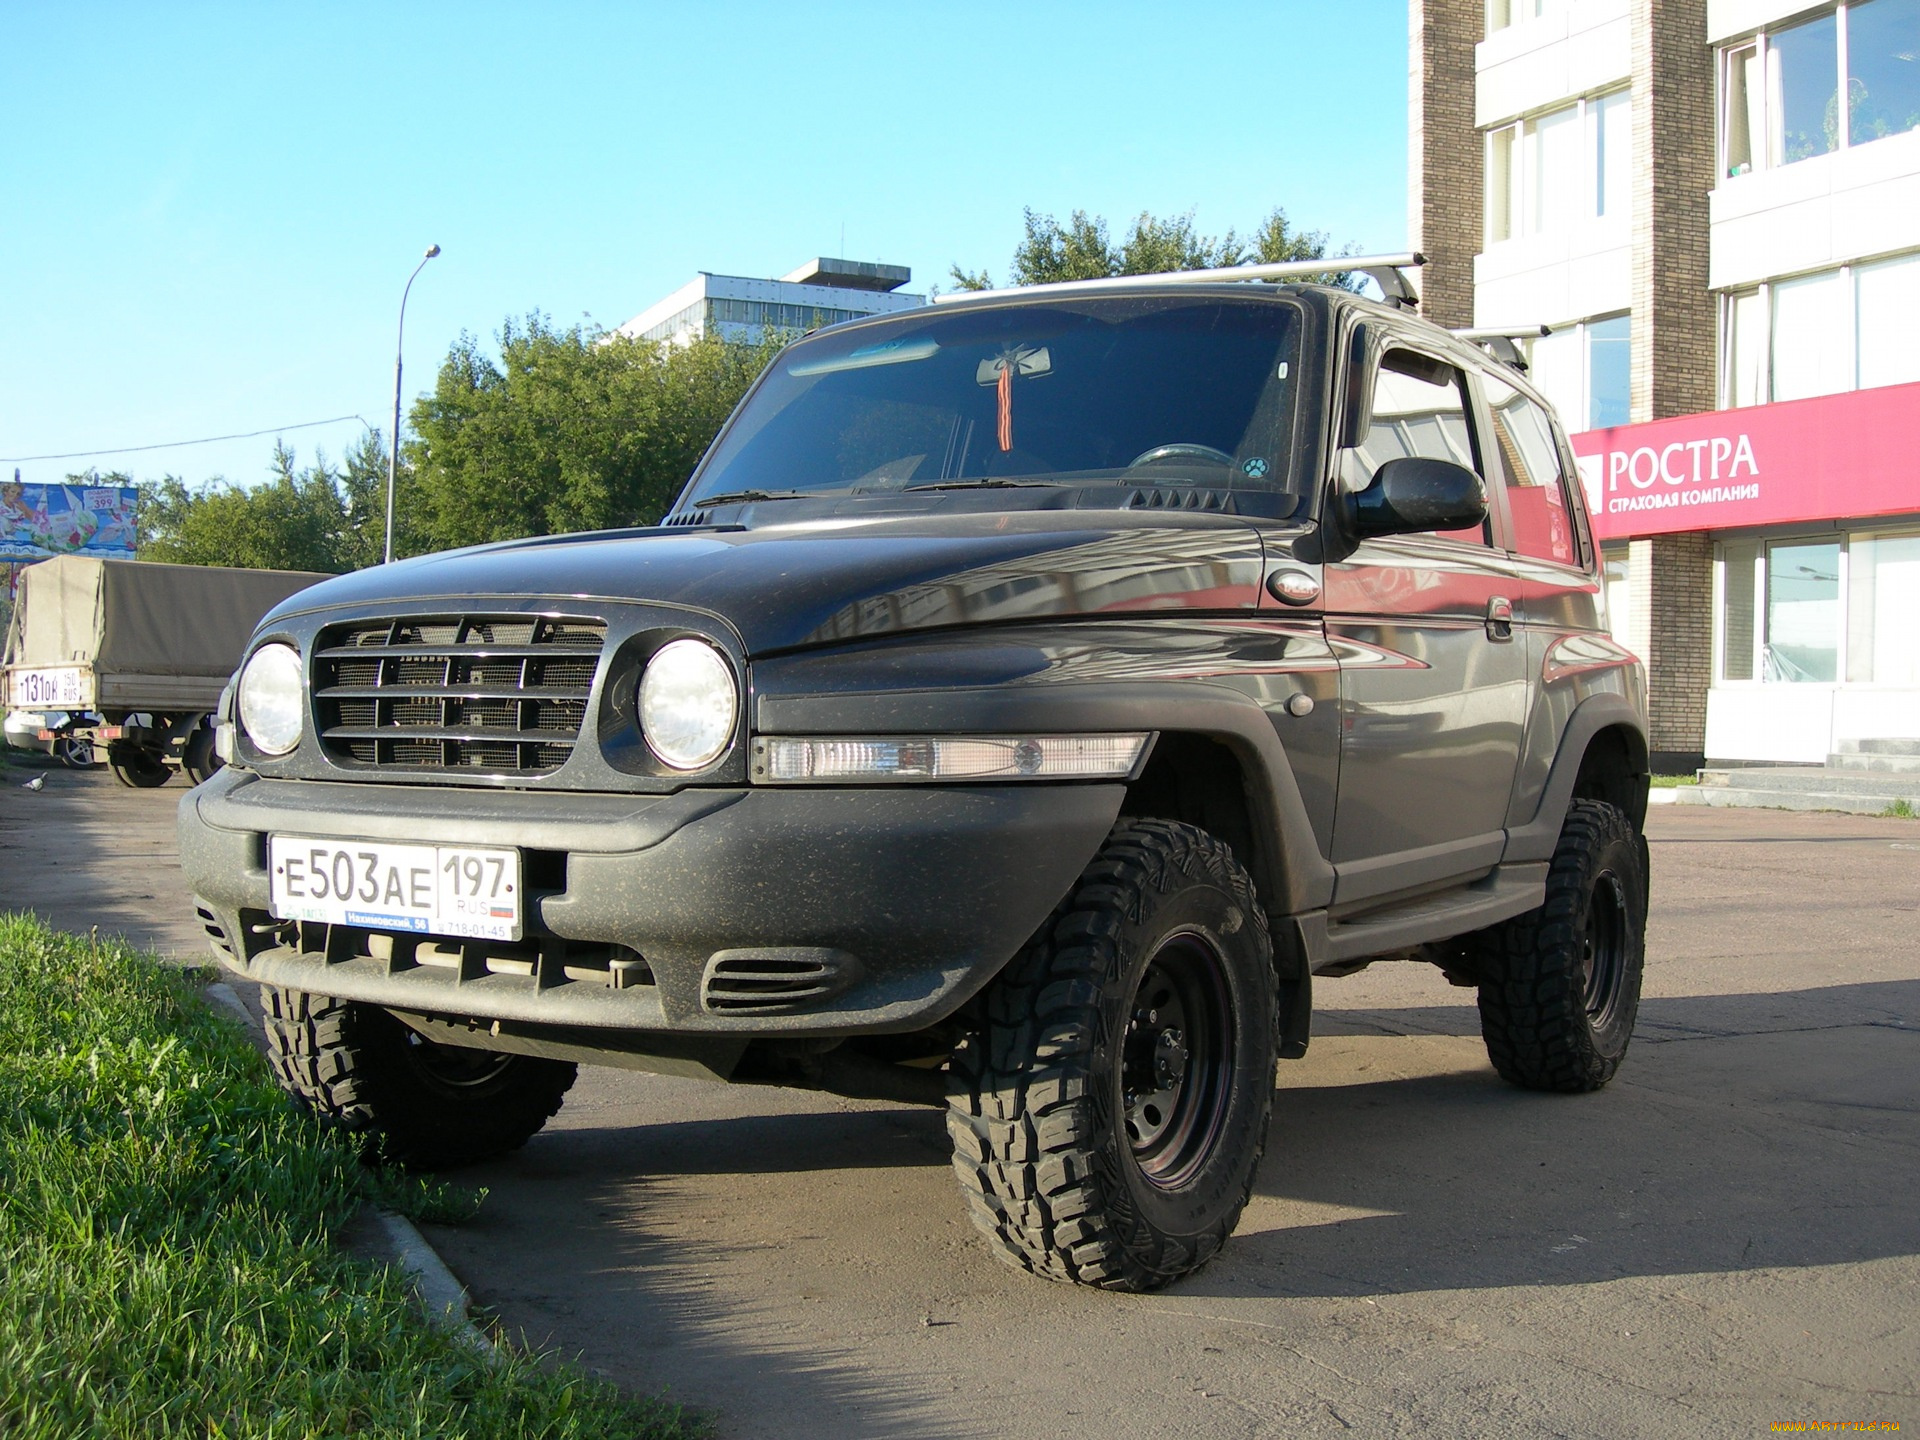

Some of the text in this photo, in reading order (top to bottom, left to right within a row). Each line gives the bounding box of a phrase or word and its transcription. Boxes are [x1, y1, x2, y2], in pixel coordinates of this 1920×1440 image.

[1609, 434, 1760, 492] РОСТРА
[94, 498, 113, 509] 399
[1609, 483, 1759, 514] СТРАХОВАЯ КОМПАНИЯ
[63, 687, 77, 701] RUS
[285, 848, 506, 909] Е503АЕ 197
[457, 899, 489, 916] RUS
[348, 911, 427, 931] Нахимовский, 56
[447, 923, 506, 937] 718-01-45
